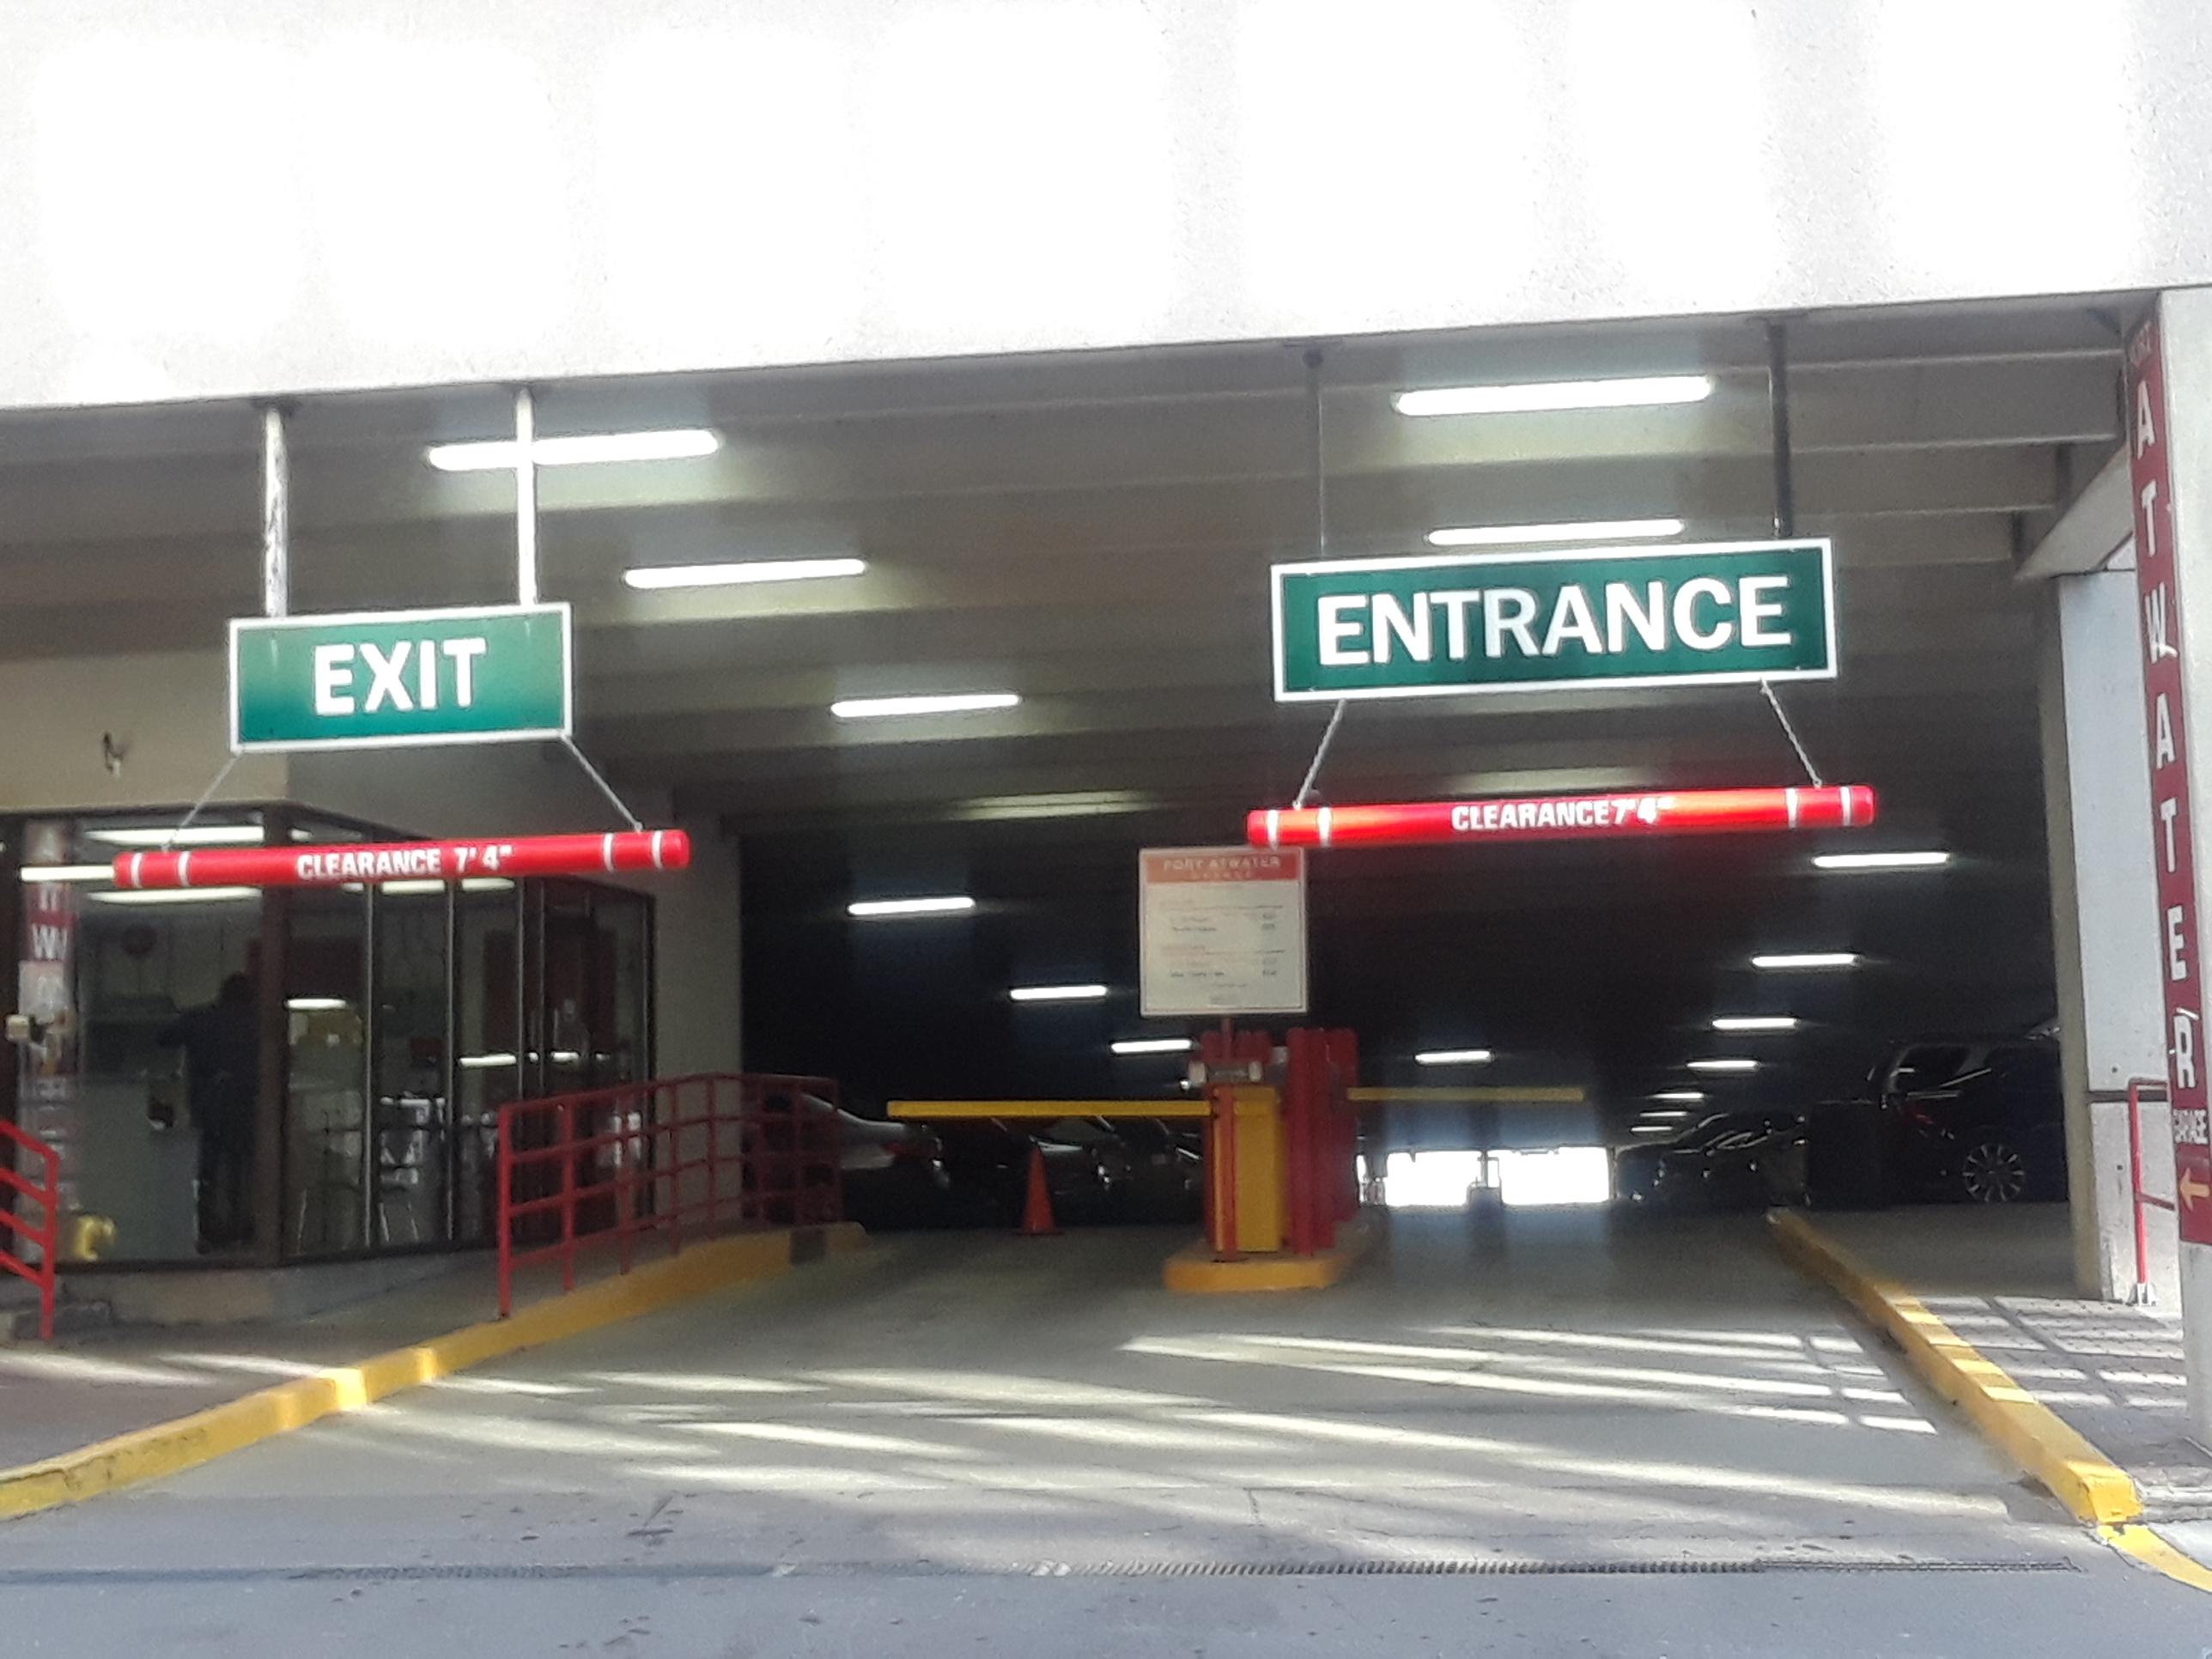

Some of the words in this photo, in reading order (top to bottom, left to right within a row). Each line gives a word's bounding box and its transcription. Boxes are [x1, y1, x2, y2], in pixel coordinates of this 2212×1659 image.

[1317, 575, 1791, 666] ENTRANCE
[314, 637, 486, 715] EXIT
[1451, 799, 1608, 830] CLEARANCE
[297, 848, 441, 879] CLEARANCE
[454, 847, 477, 874] 7'
[483, 845, 513, 871] 4"
[1208, 856, 1280, 869] ATWATER
